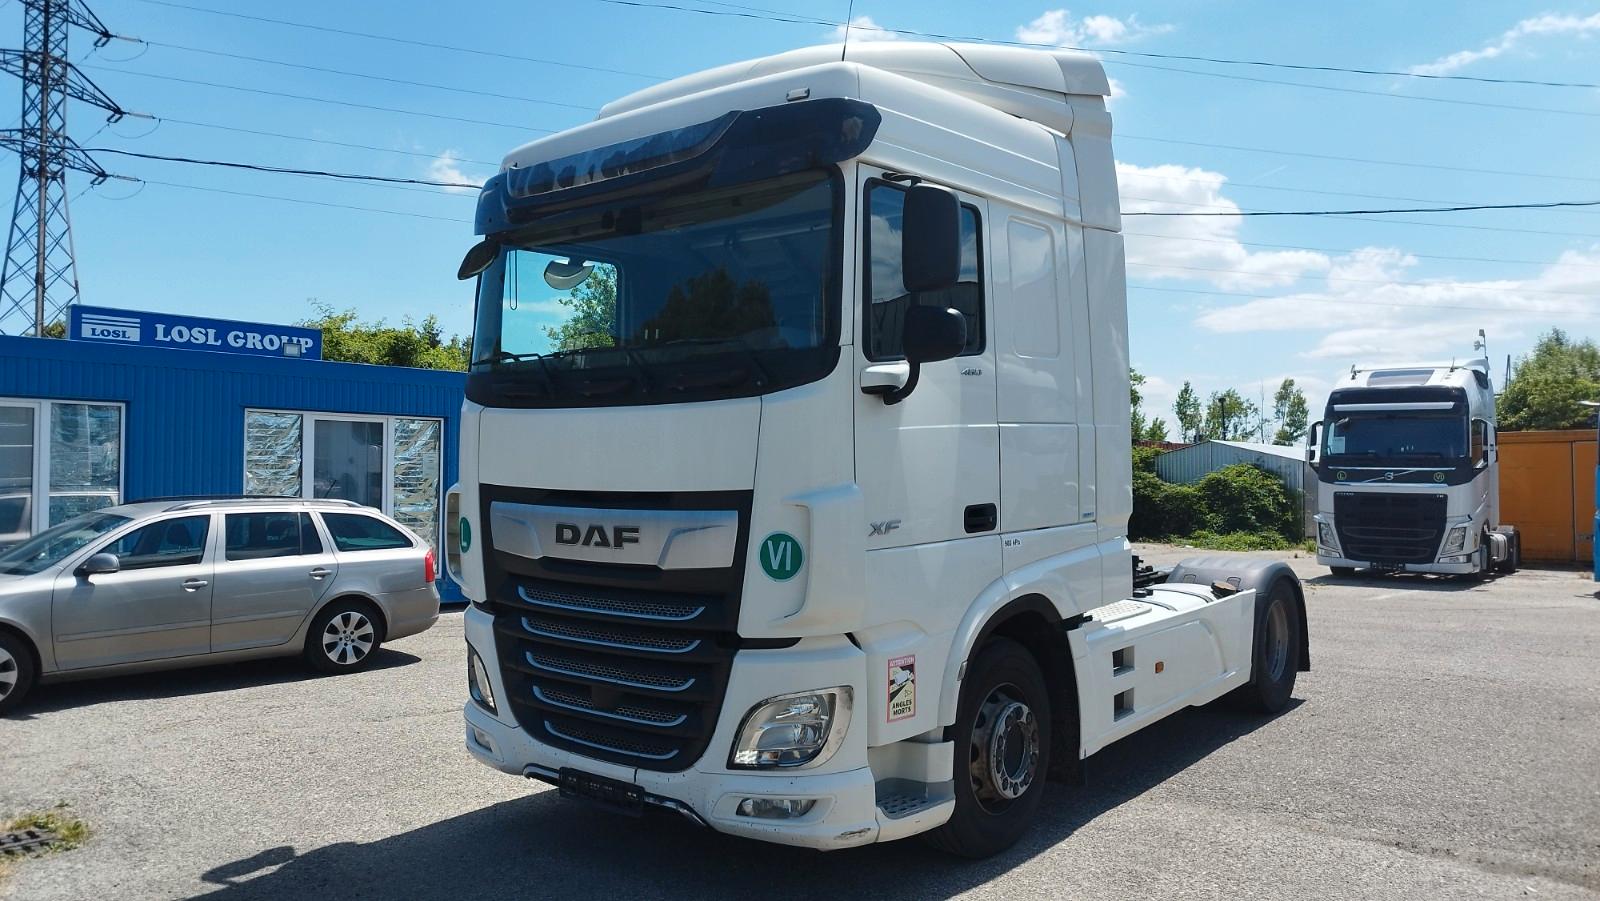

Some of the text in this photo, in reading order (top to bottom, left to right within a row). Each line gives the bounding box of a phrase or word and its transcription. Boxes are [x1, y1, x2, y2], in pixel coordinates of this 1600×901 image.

[91, 328, 130, 340] LOSL
[155, 323, 221, 346] LOSL
[555, 523, 640, 549] DAF
[868, 519, 902, 537] XF
[767, 540, 792, 571] VI
[893, 700, 912, 709] ANGLES
[893, 706, 911, 716] MORTS
